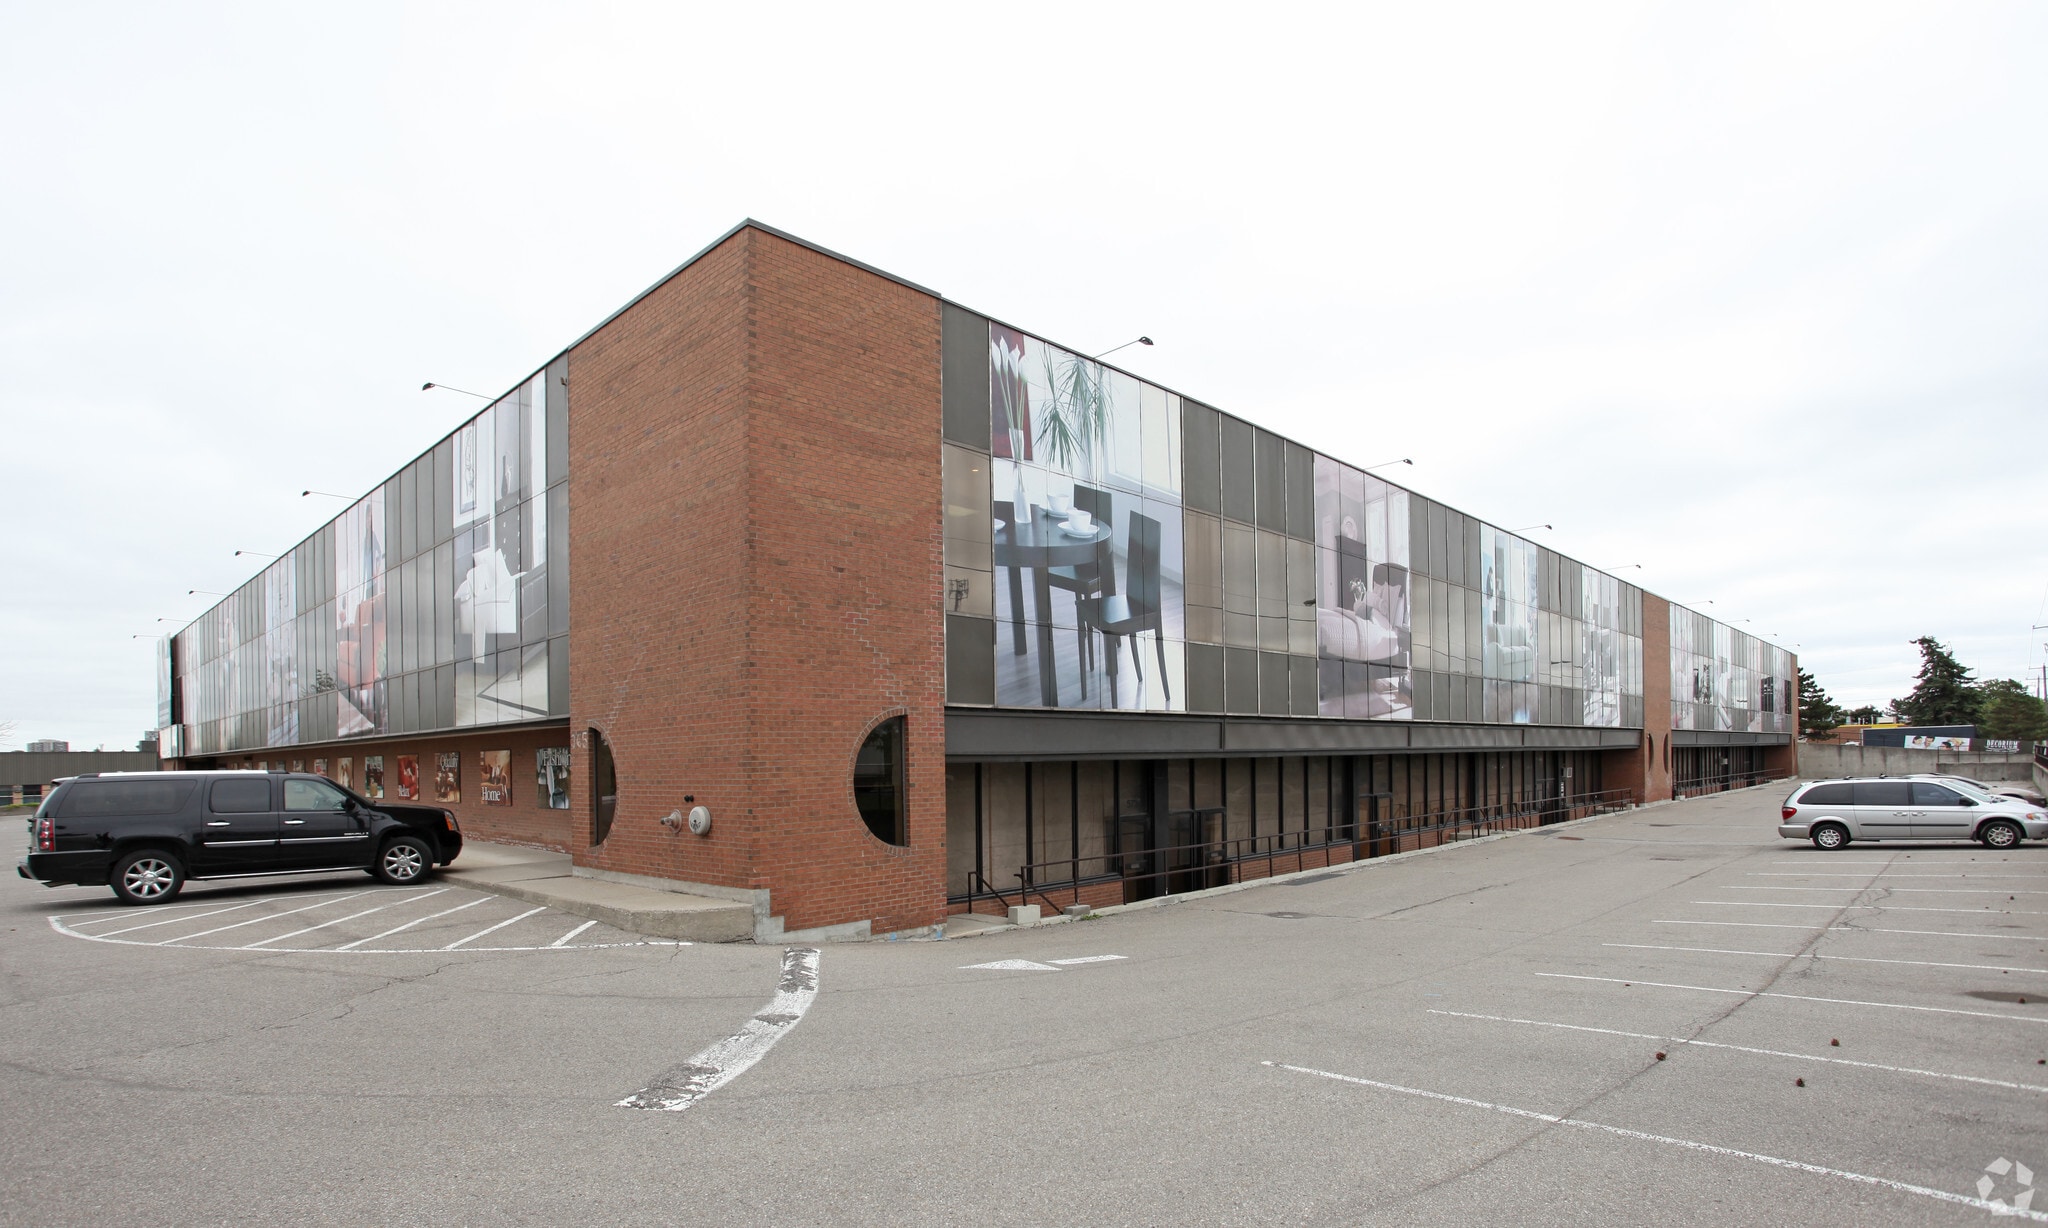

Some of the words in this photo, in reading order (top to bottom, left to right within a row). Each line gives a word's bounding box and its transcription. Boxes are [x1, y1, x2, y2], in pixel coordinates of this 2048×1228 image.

[1986, 739, 2018, 749] DECORIUM
[543, 749, 571, 766] Fashion
[481, 786, 501, 802] Home
